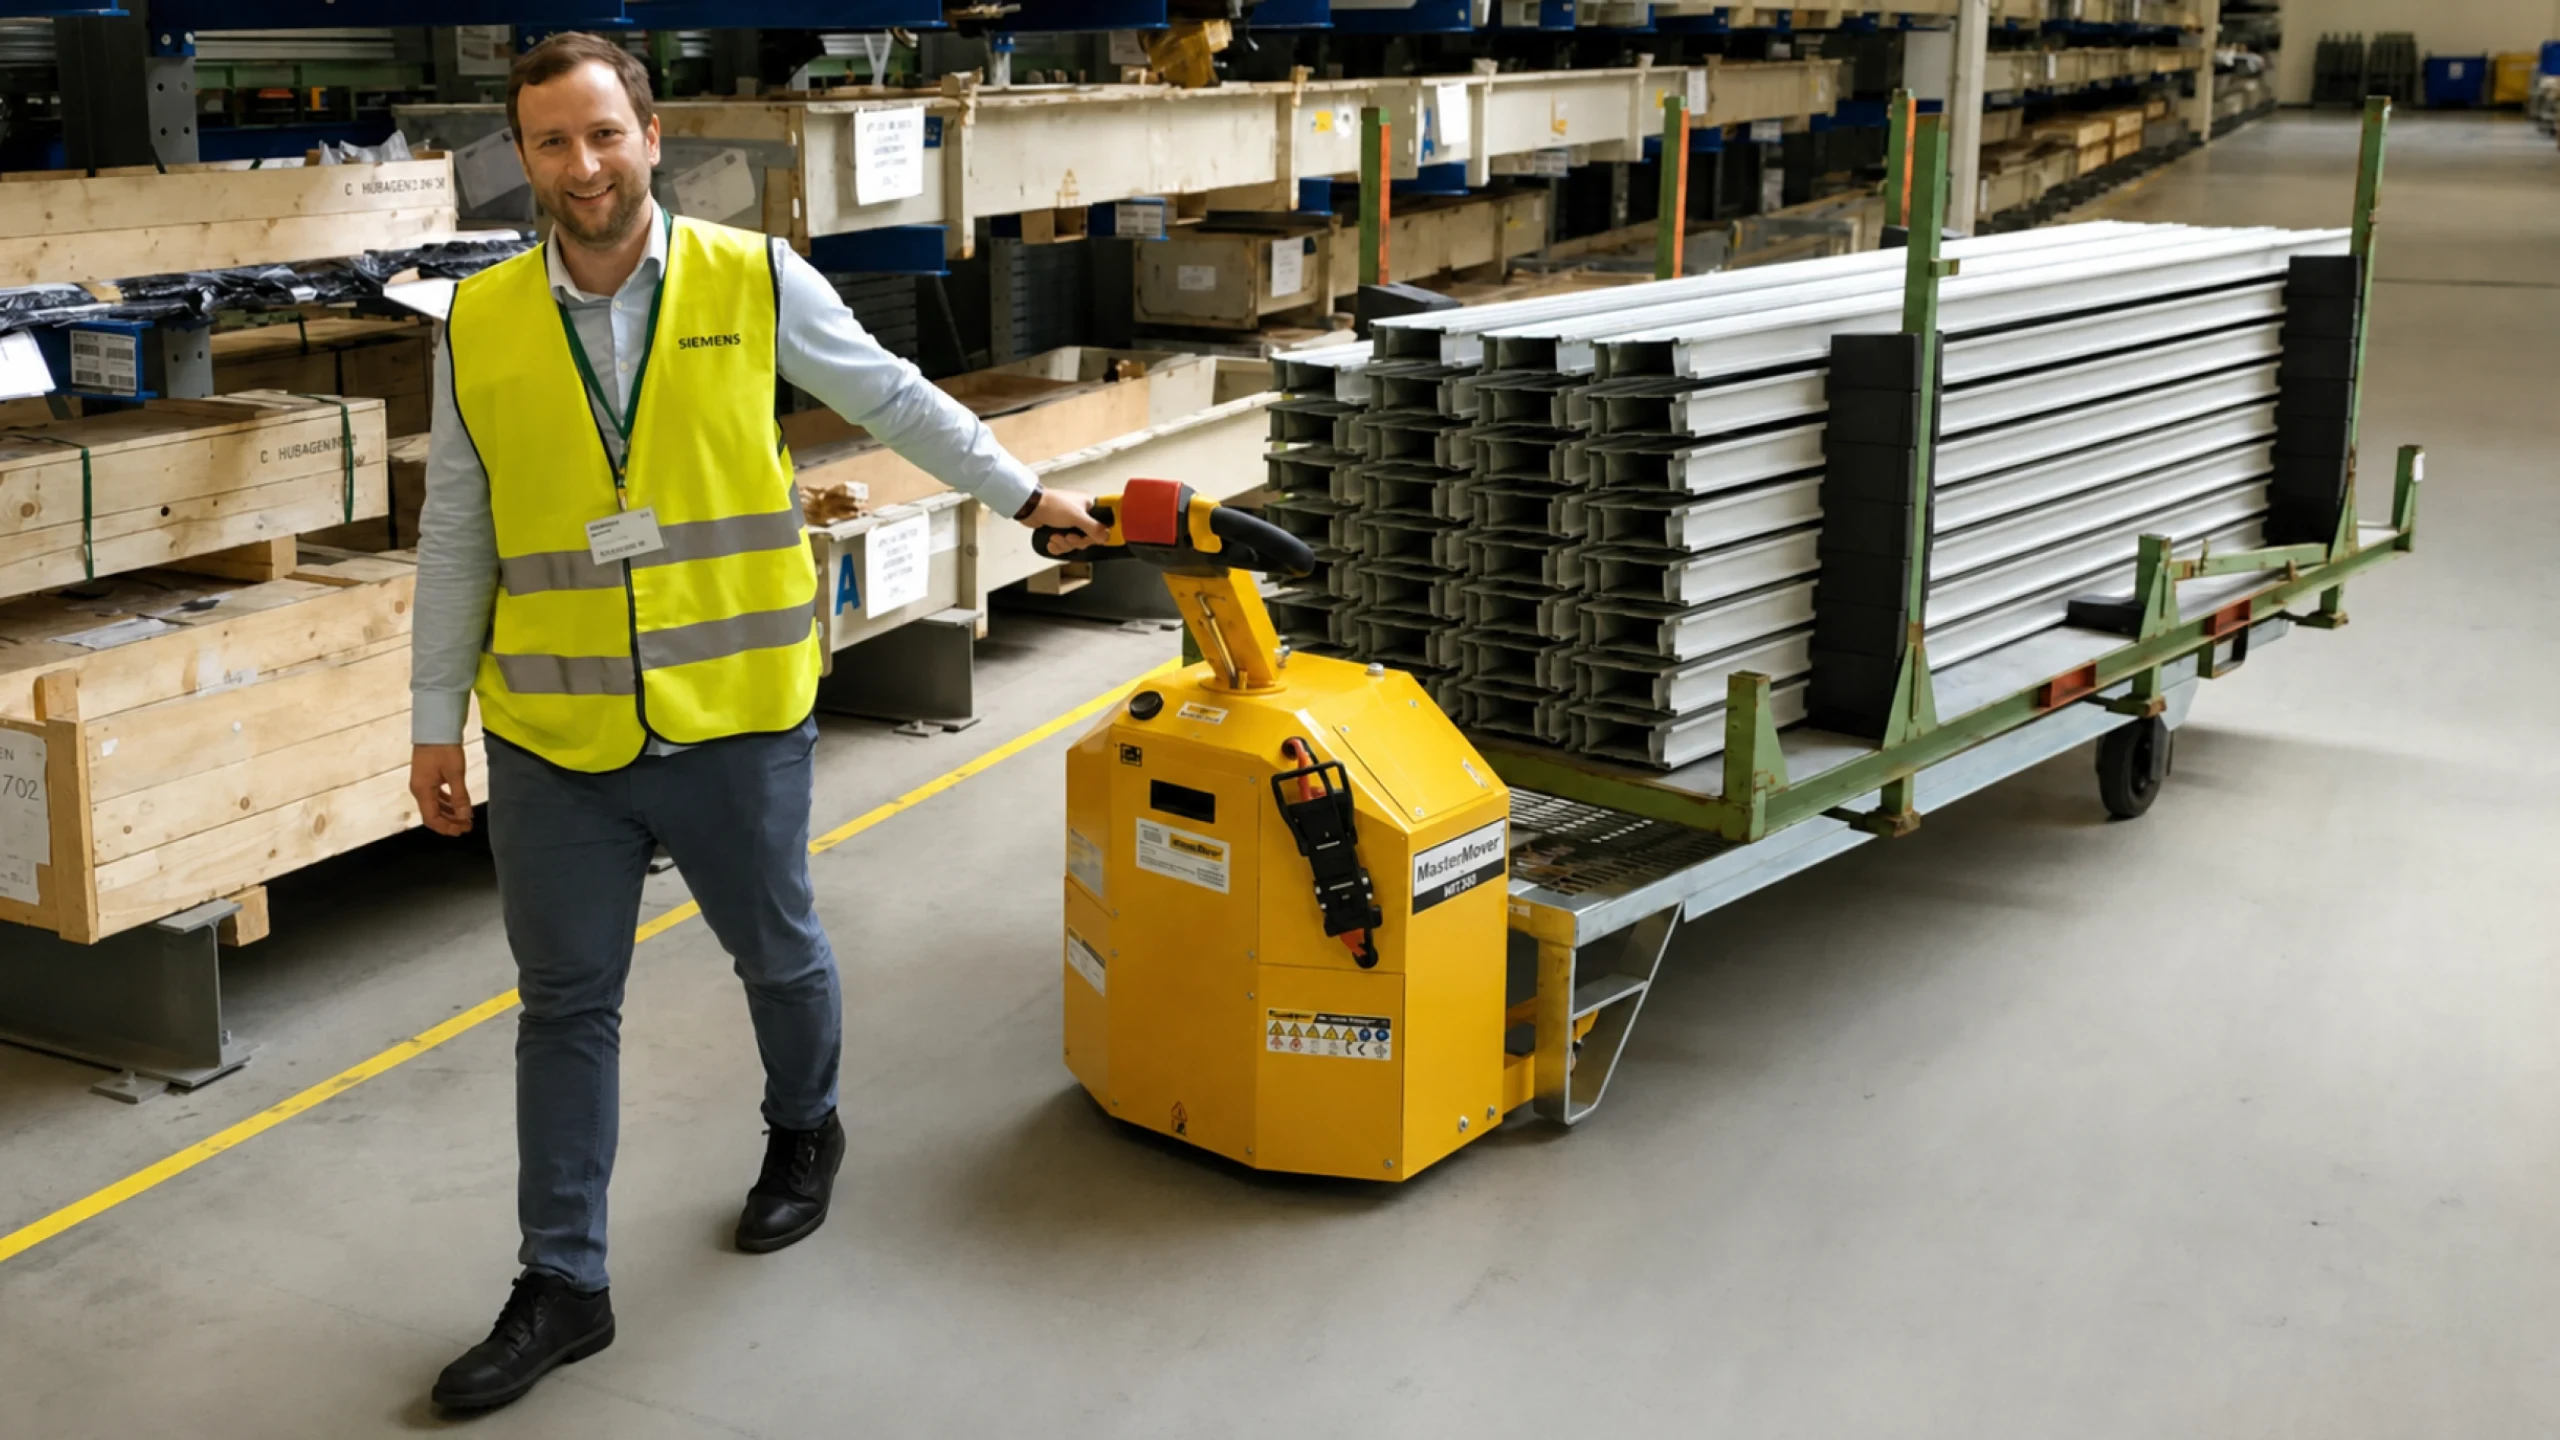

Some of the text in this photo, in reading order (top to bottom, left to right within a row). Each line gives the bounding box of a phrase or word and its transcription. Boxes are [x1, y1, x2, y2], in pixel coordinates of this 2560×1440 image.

[678, 333, 741, 350] SIEMENS
[835, 553, 861, 616] A
[3, 774, 39, 801] 702
[1417, 836, 1501, 882] MasterMover
